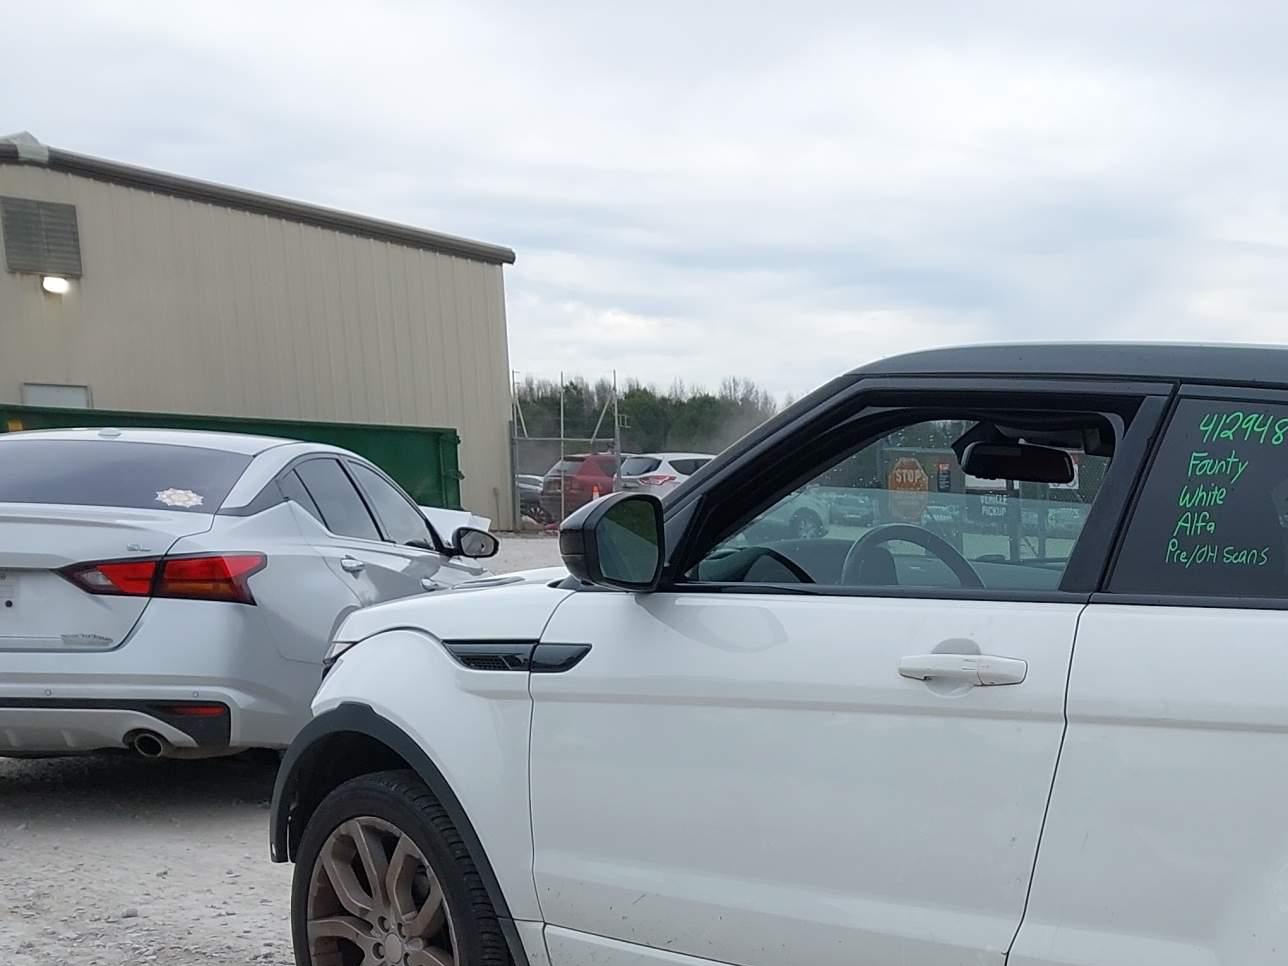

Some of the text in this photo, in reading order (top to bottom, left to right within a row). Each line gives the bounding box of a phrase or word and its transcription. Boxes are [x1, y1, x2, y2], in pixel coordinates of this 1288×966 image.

[895, 469, 921, 483] STOP
[980, 494, 1008, 505] VEHICLE
[1179, 483, 1227, 508] White
[981, 506, 1007, 516] PICKUP
[1173, 512, 1216, 537] Alfa
